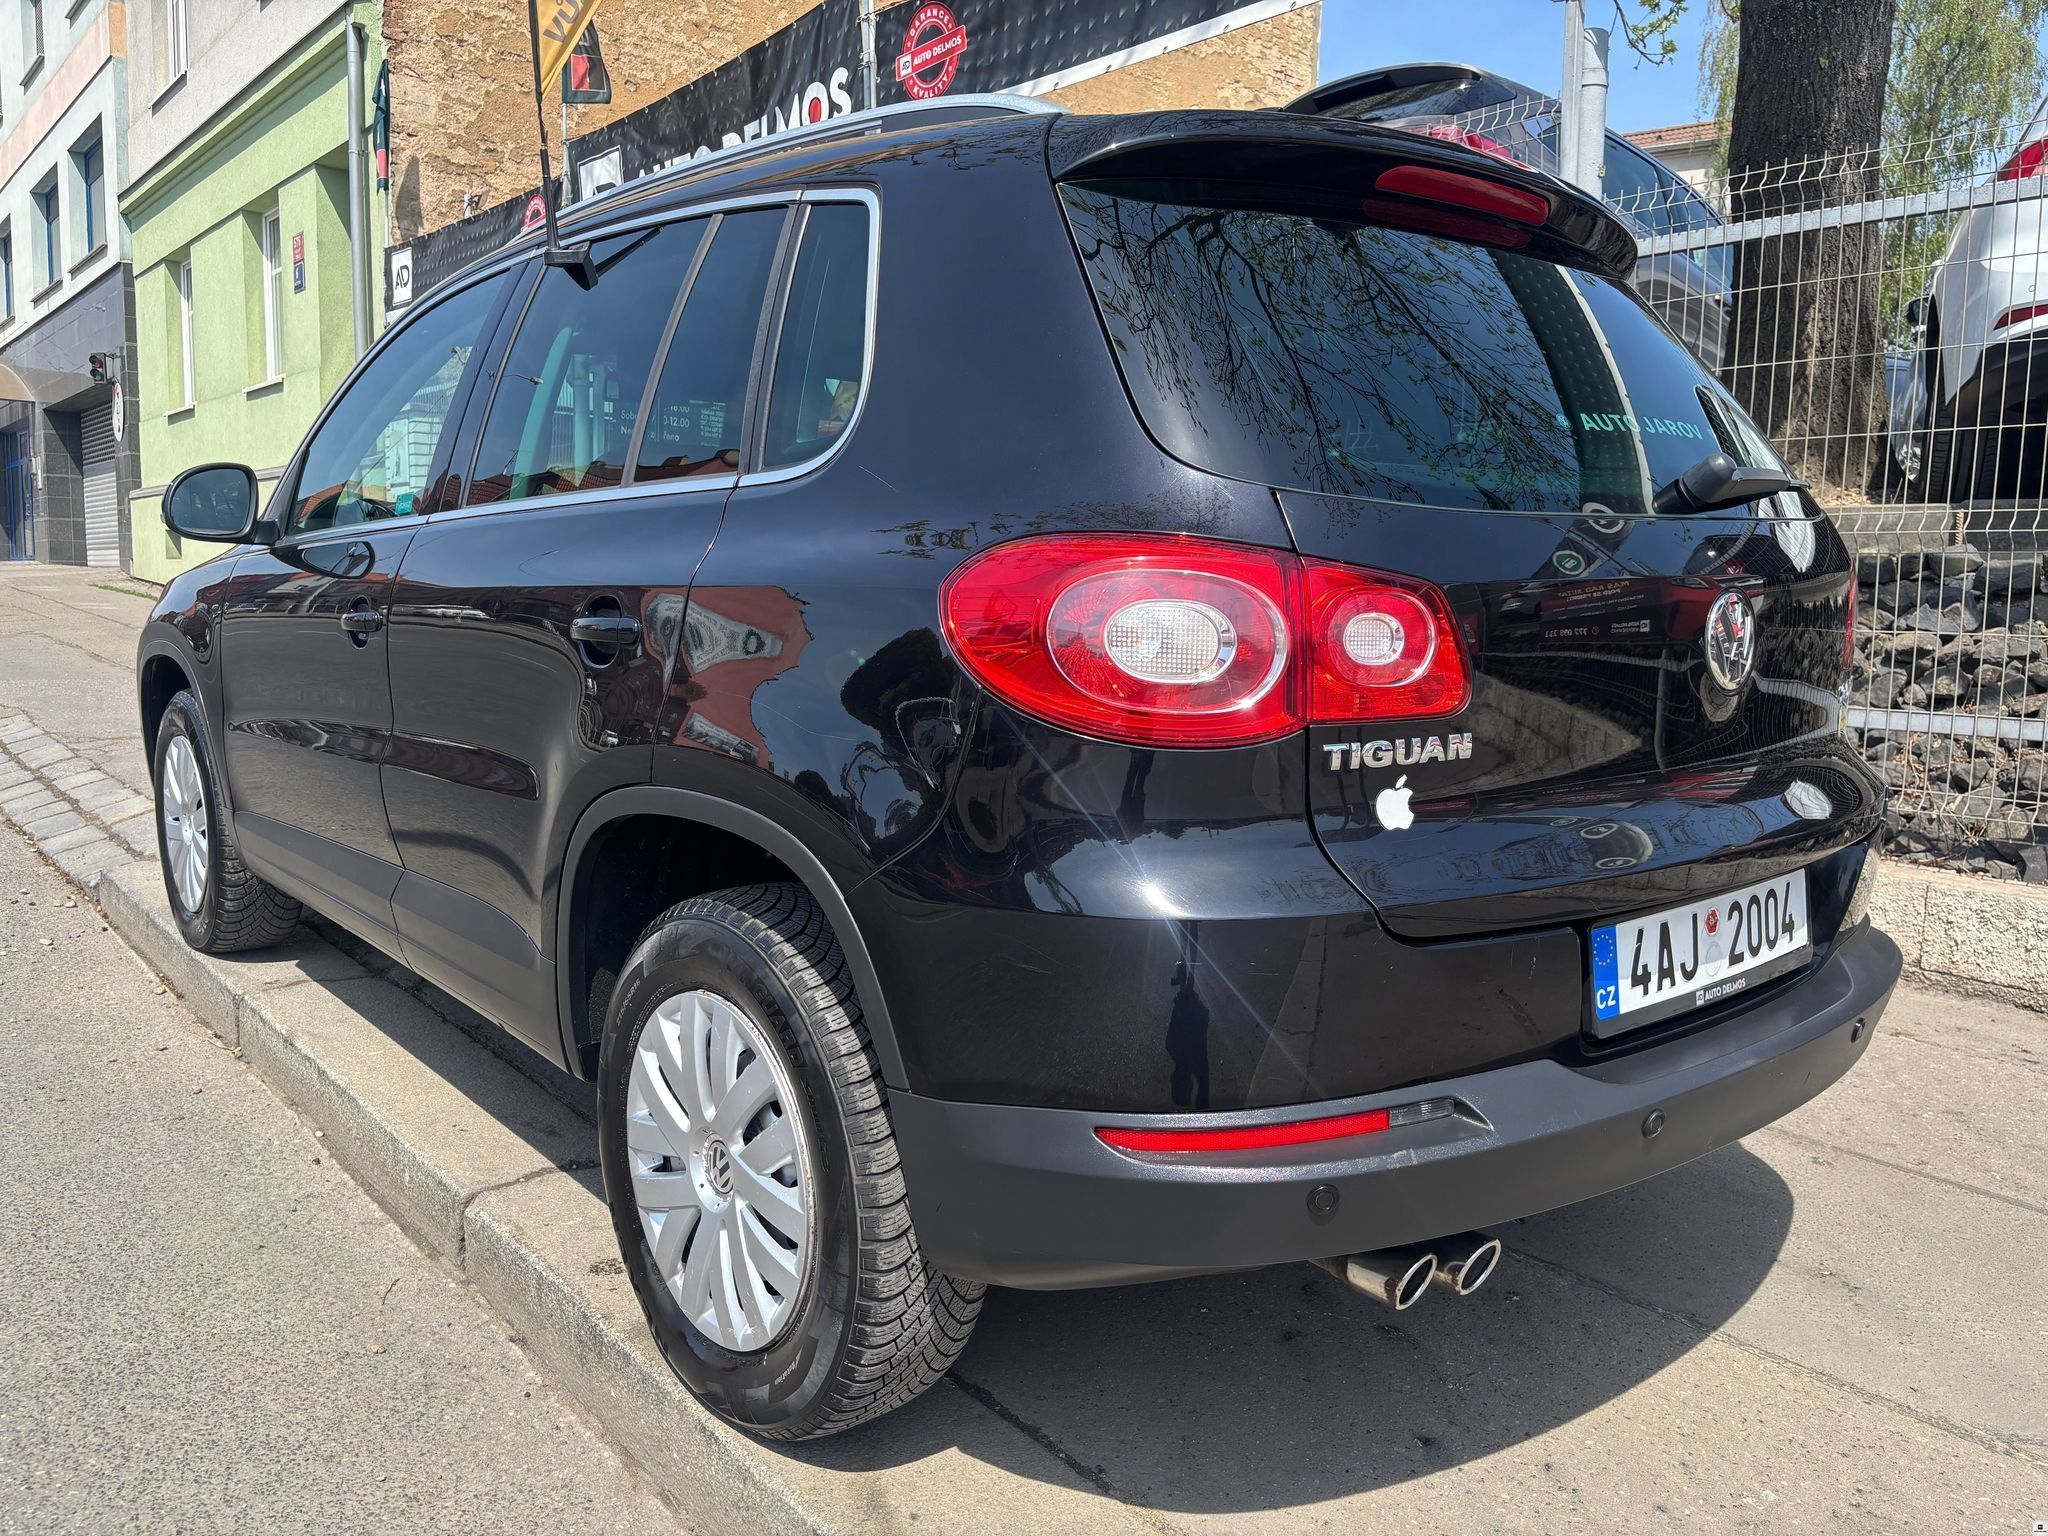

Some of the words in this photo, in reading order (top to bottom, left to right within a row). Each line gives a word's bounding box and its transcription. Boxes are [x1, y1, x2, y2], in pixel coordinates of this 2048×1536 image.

[910, 8, 950, 36] GARANCE
[913, 50, 931, 66] AUTO
[933, 35, 962, 56] DELMOS
[913, 74, 948, 99] KVALITY
[395, 265, 410, 290] AD
[1580, 413, 1641, 433] AUTO
[1643, 416, 1704, 440] JAROV
[1323, 733, 1473, 771] TIGUAN
[1630, 912, 1699, 997] 4AJ
[1727, 882, 1795, 967] 2004
[1597, 985, 1616, 1009] CZ
[1704, 987, 1721, 1001] AUTO
[1722, 978, 1746, 995] DELMOS
